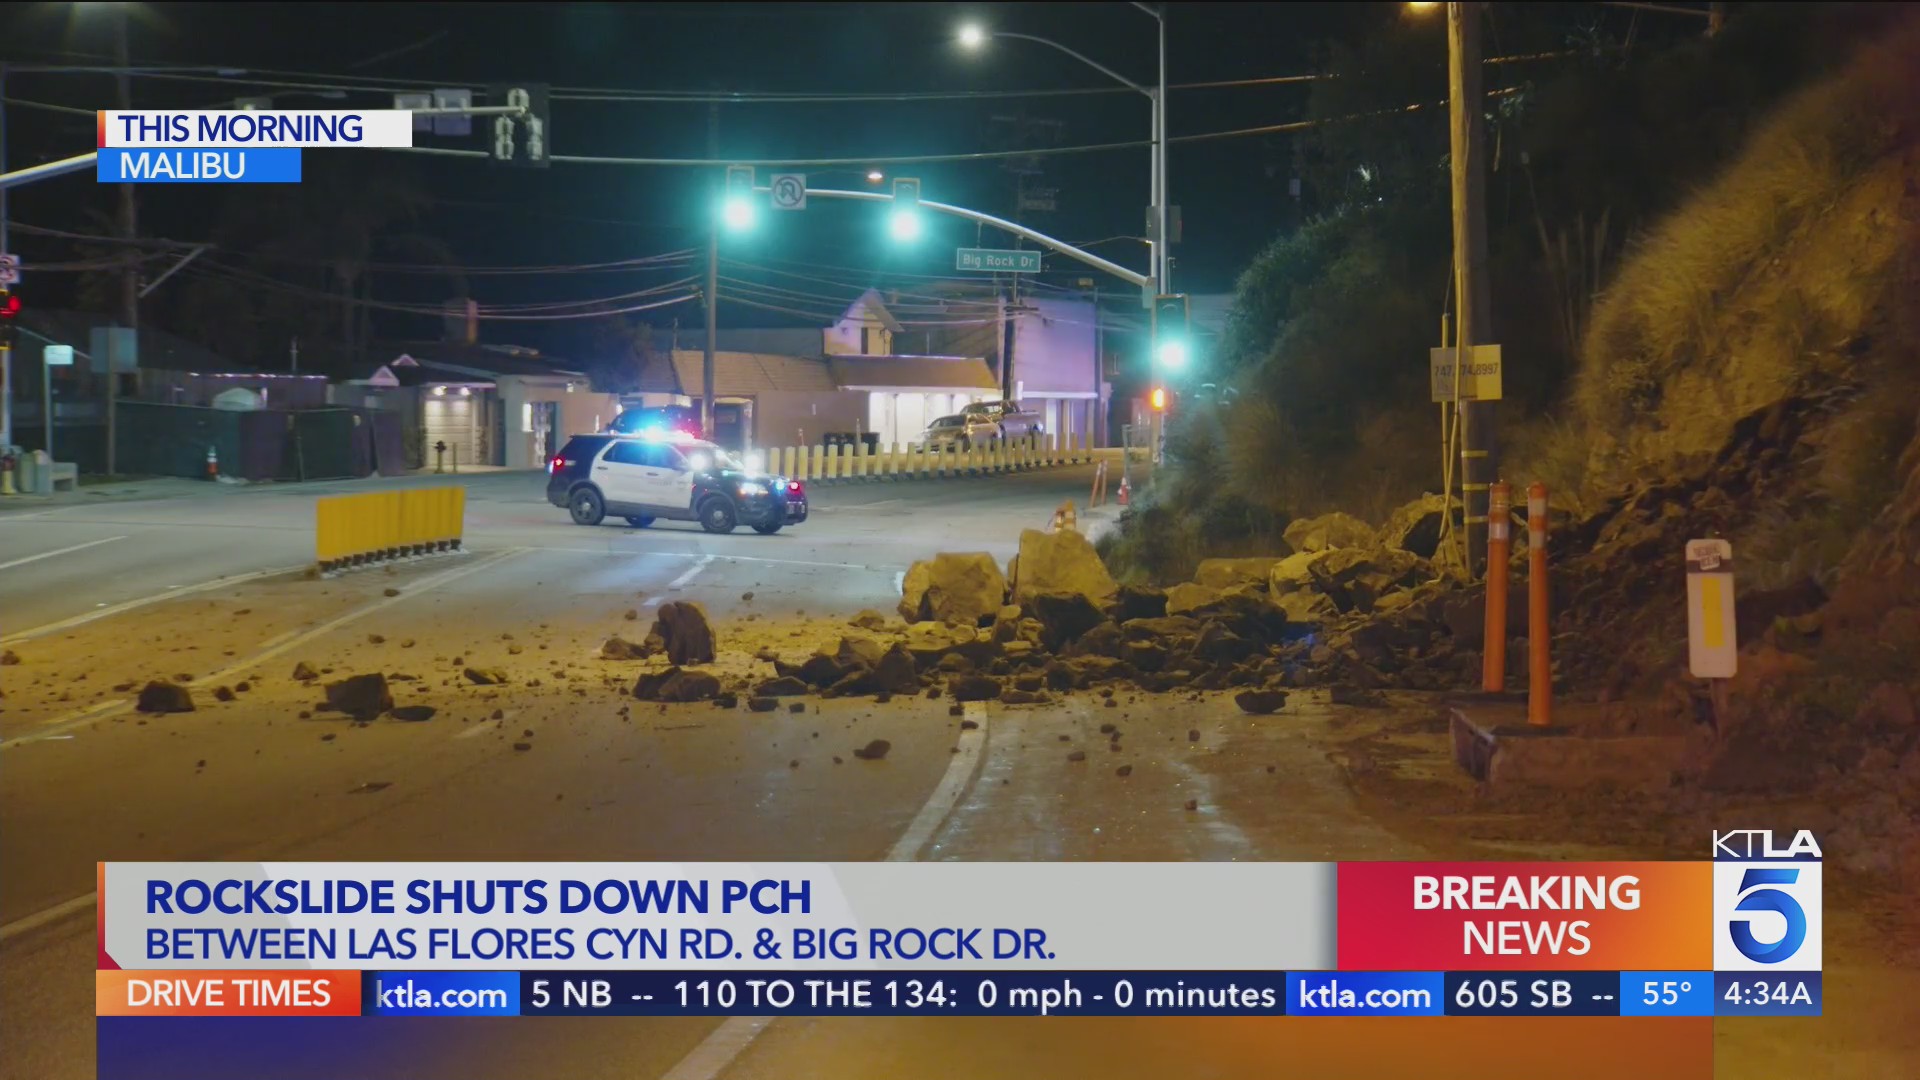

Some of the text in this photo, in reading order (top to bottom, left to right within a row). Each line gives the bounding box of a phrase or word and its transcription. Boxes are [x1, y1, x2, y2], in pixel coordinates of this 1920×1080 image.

[963, 253, 1034, 268] Big Rock Dr
